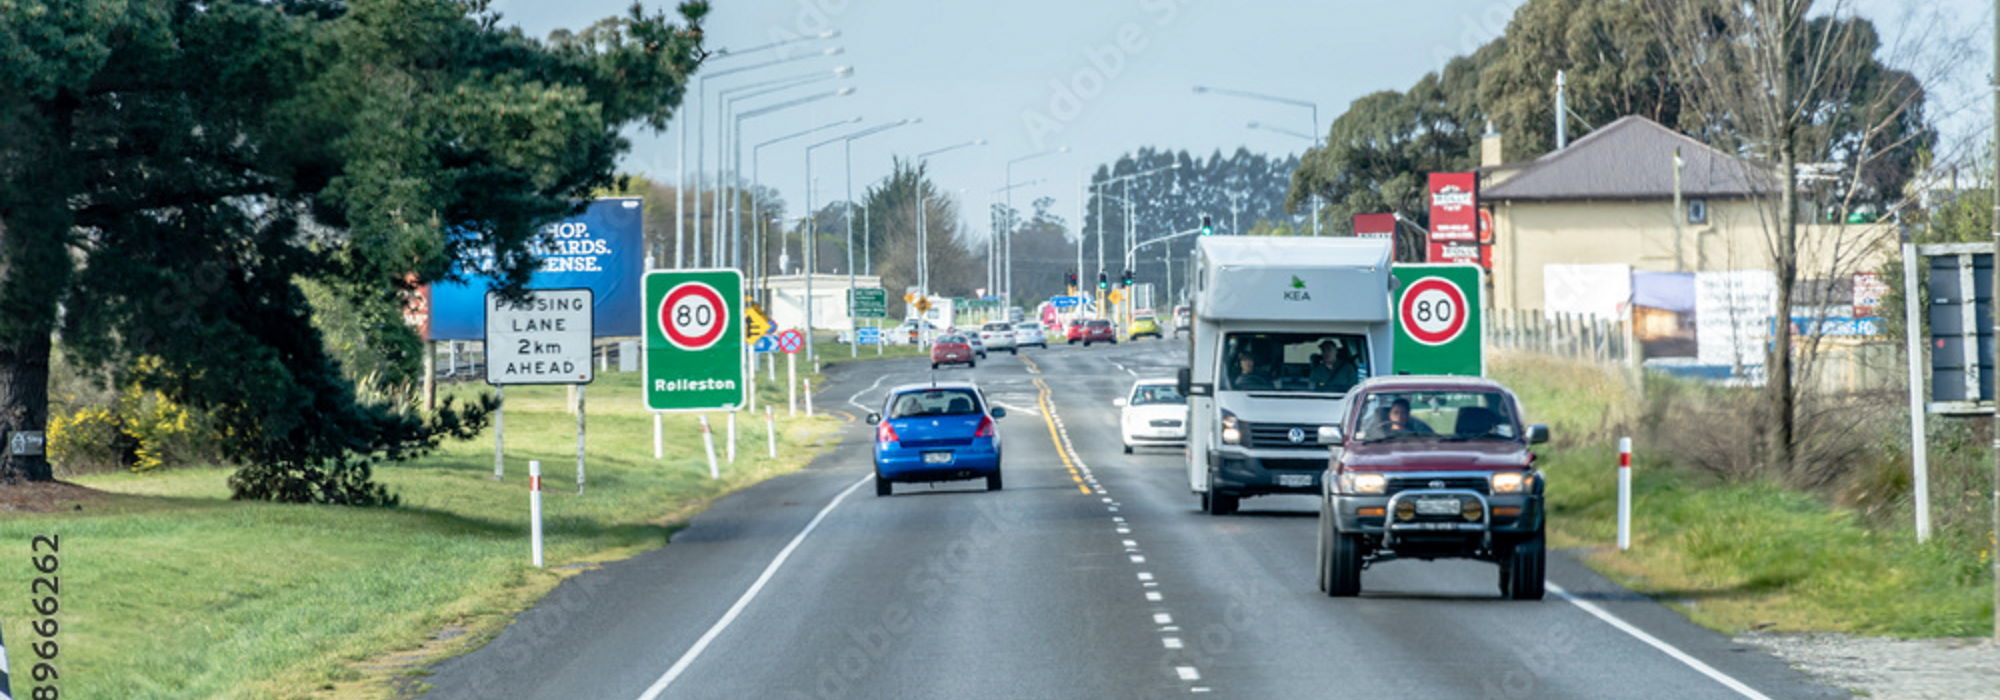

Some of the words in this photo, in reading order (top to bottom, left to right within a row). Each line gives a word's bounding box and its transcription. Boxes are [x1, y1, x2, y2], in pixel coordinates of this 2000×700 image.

[544, 222, 590, 238] HOP.
[541, 257, 602, 272] ENSE.
[1283, 291, 1311, 301] KEA
[495, 298, 583, 311] PASSING
[1417, 300, 1451, 322] 80
[677, 304, 711, 327] 80
[512, 318, 566, 332] LANE
[505, 361, 575, 374] AHEAD
[655, 378, 735, 392] Rolleston
